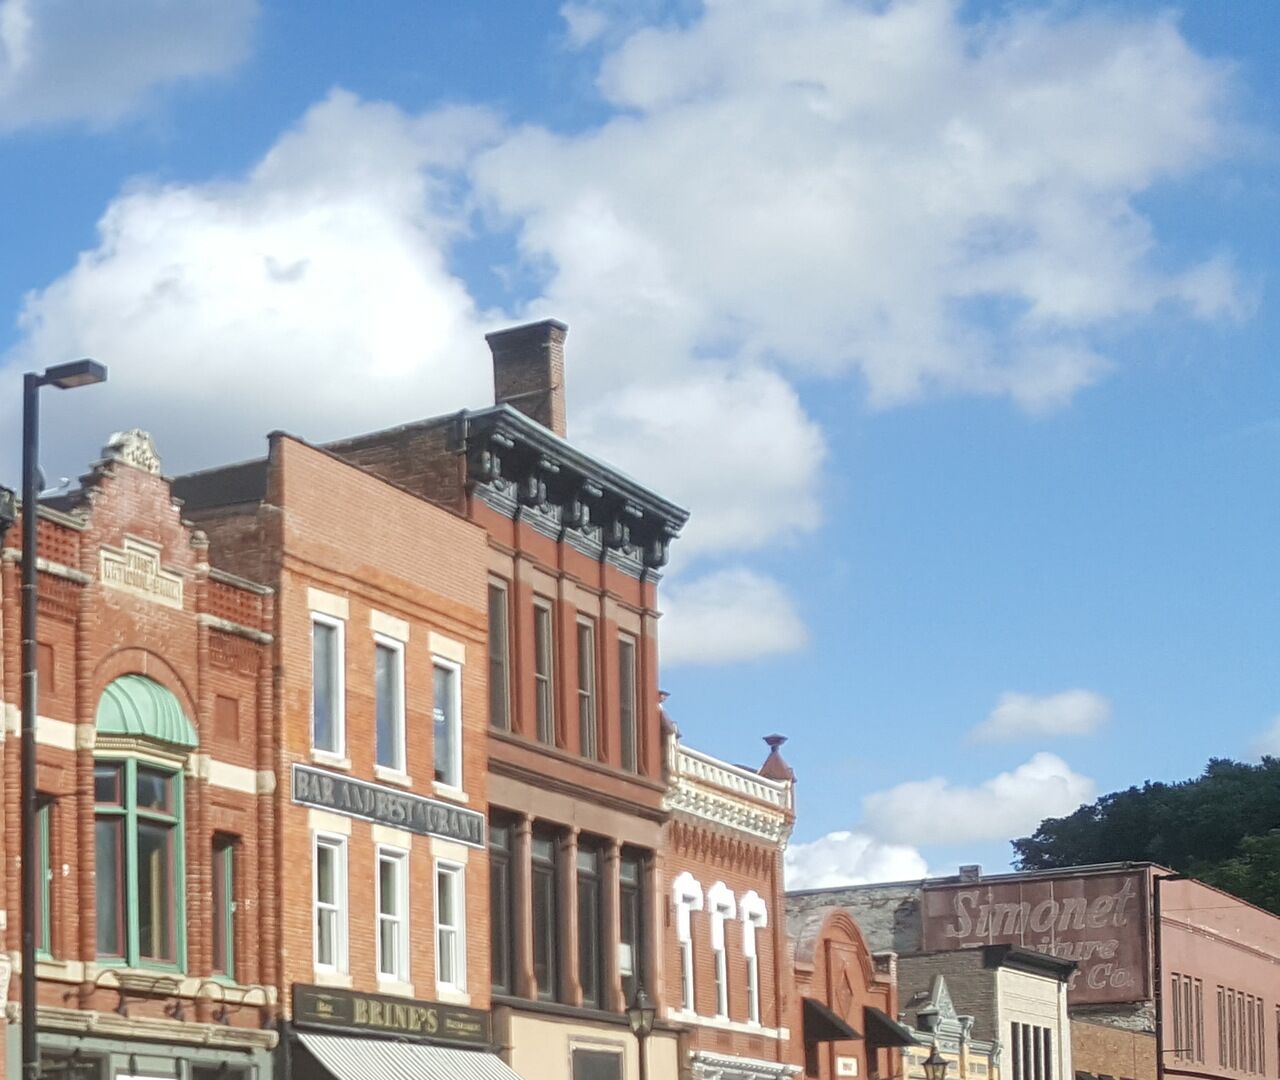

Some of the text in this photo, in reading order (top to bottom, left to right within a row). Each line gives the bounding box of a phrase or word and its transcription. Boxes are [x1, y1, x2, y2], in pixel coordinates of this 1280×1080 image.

[296, 771, 335, 804] BAR
[340, 782, 375, 814] AND
[944, 877, 1136, 938] Simonet
[352, 998, 439, 1034] BRINE'S
